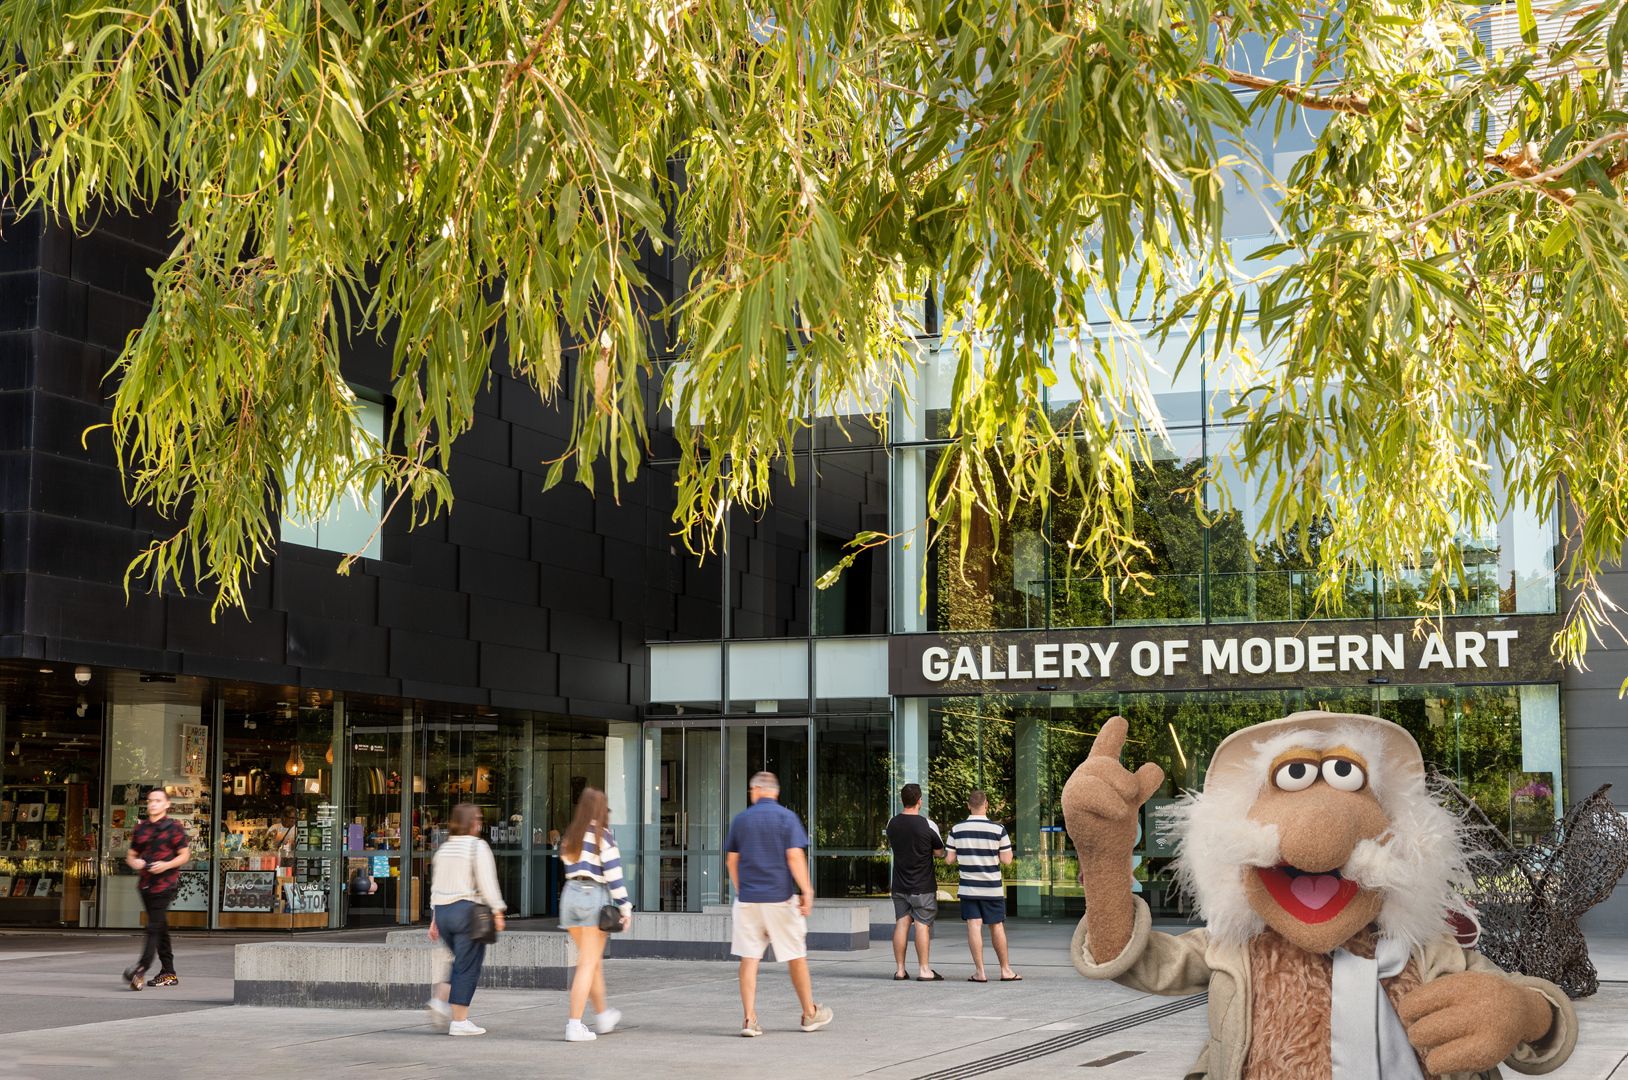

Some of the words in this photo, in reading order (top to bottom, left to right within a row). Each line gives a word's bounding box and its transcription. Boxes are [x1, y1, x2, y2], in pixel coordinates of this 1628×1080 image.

[922, 642, 1120, 681] GALLERY
[1130, 640, 1189, 676] OF
[1202, 633, 1405, 675] MODERN
[1418, 630, 1519, 669] ART
